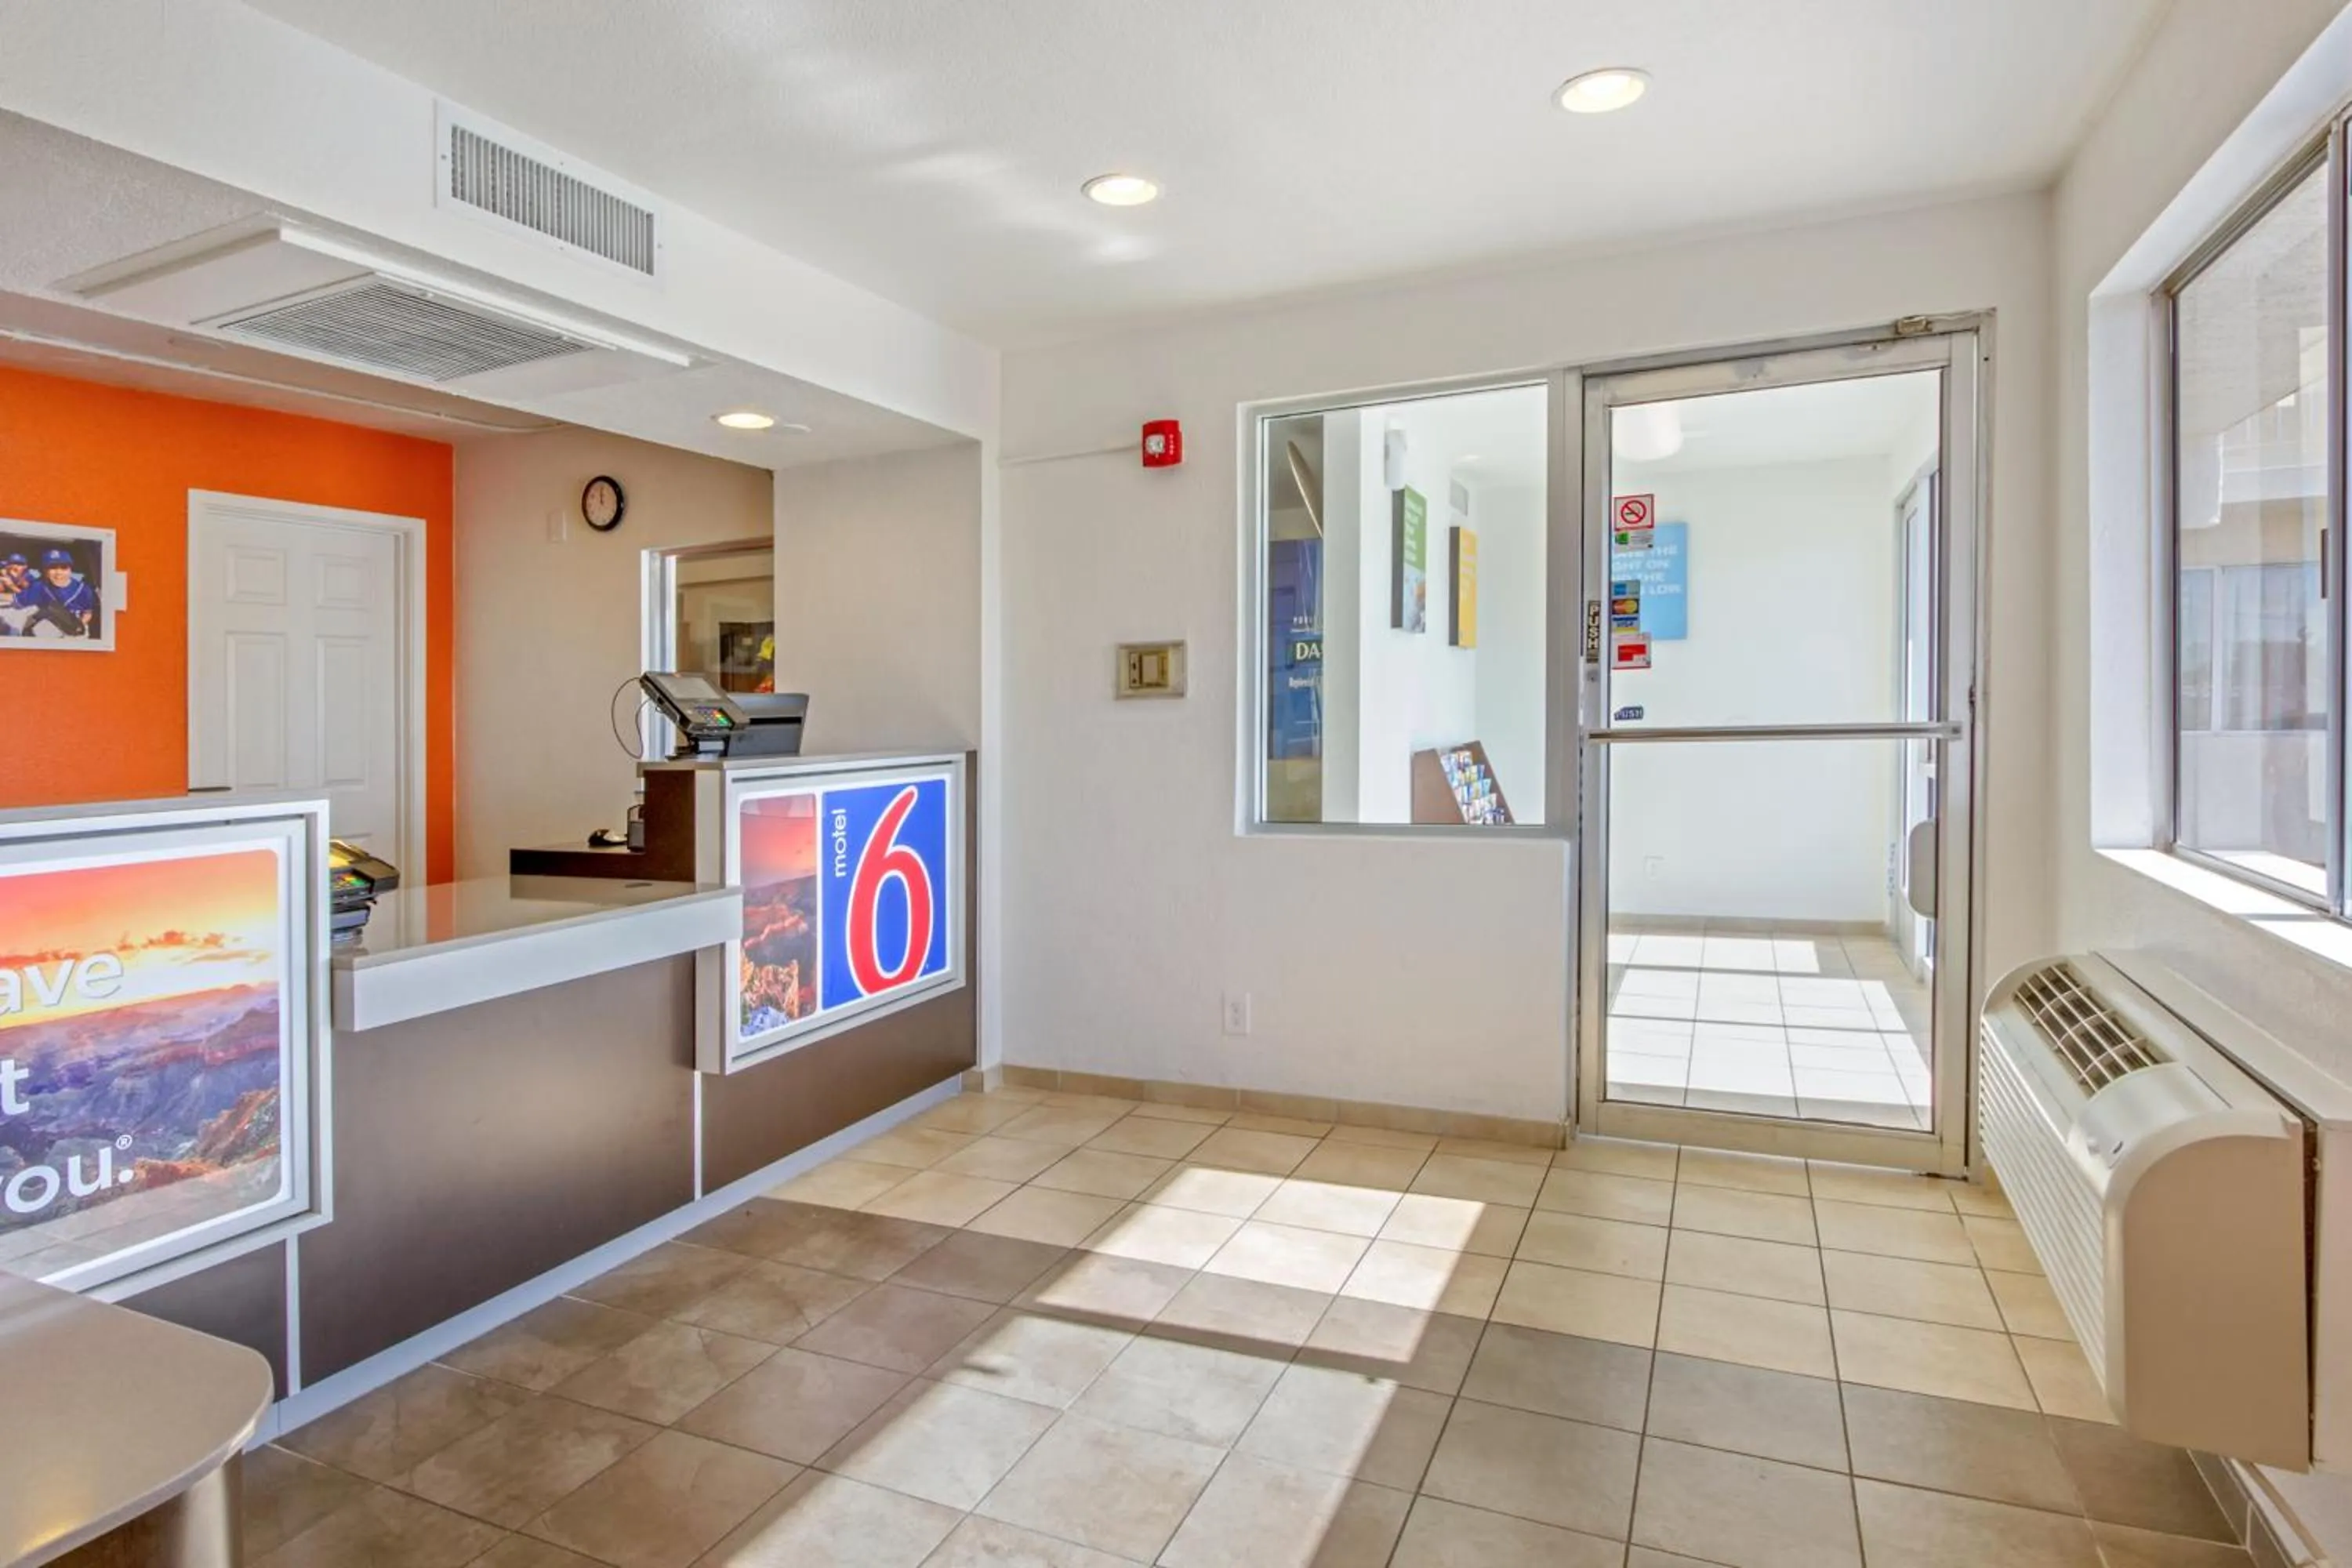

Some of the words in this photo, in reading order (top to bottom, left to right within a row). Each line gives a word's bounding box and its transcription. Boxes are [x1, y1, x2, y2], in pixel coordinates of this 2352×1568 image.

[1588, 604, 1599, 649] PUSH
[831, 808, 848, 878] motel
[845, 785, 934, 998] 6
[0, 952, 124, 1016] ave
